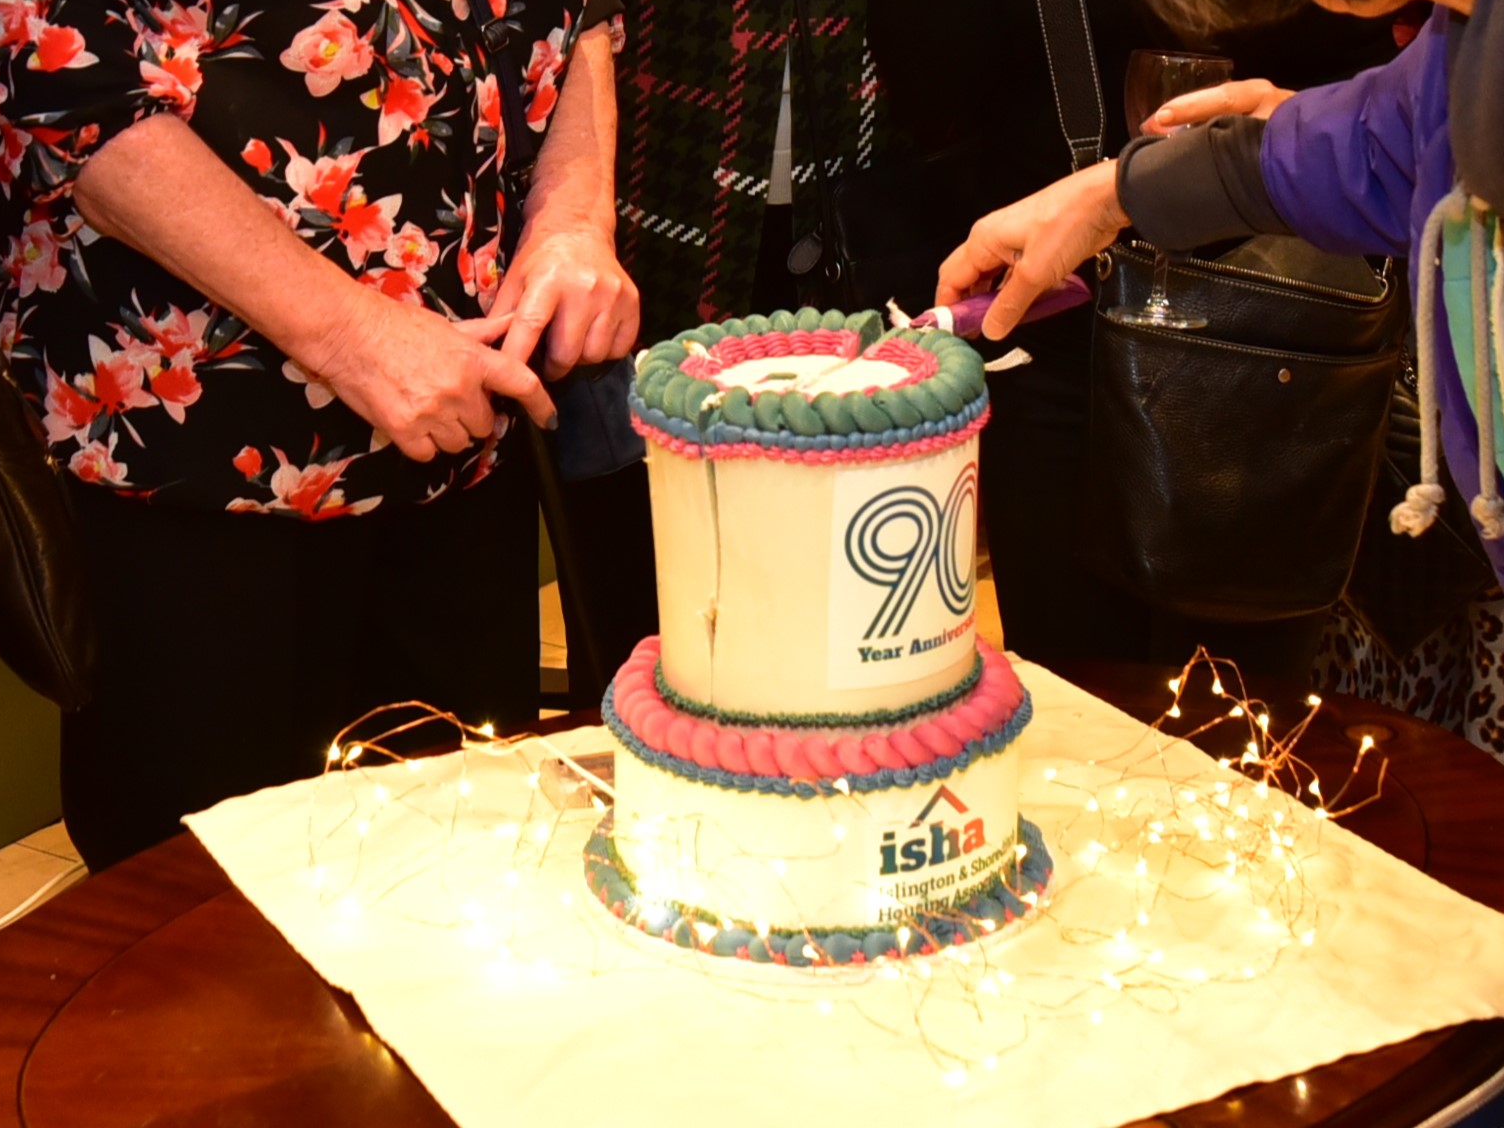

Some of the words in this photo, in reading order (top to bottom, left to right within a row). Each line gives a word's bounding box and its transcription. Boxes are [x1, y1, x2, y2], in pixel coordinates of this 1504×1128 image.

[845, 461, 977, 640] 90
[857, 646, 904, 663] Year
[880, 817, 985, 876] isha
[958, 865, 969, 881] &
